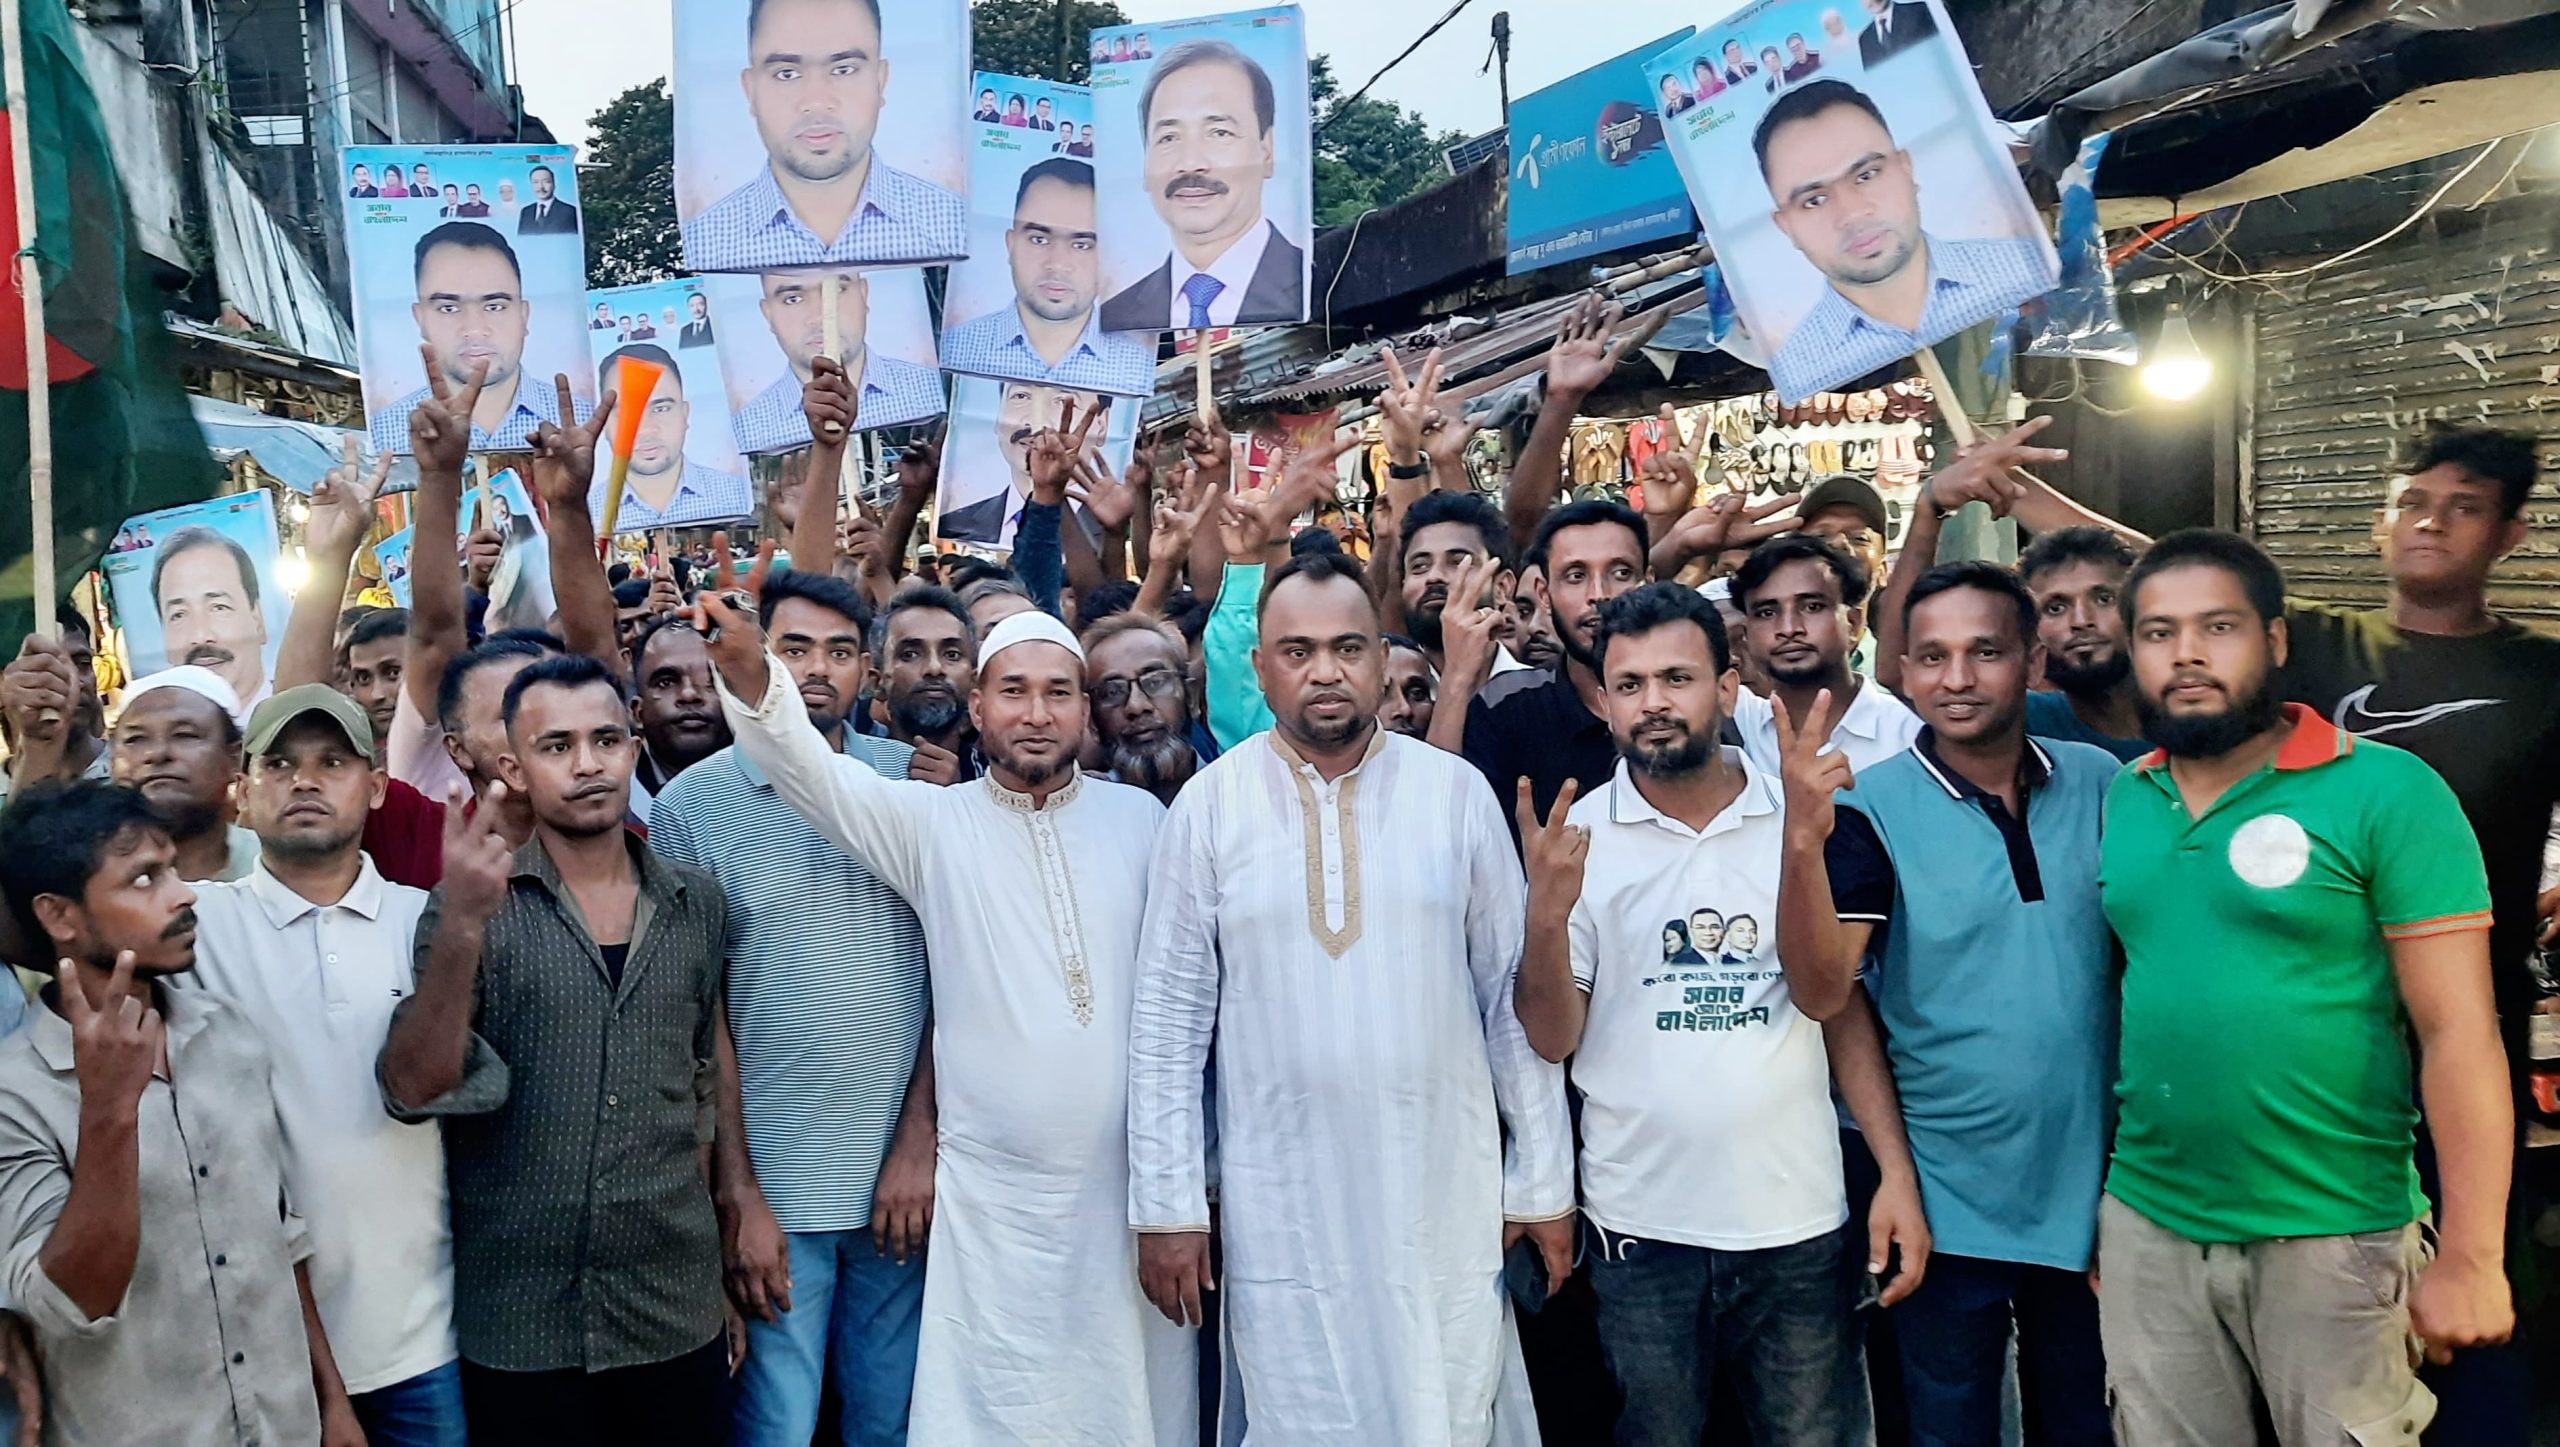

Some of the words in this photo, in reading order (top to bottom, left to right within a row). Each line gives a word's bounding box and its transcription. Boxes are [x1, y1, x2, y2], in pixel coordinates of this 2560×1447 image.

[1683, 986, 1745, 1008] সবার
[1655, 1006, 1769, 1032] বাংলাদেশ
[1694, 1004, 1731, 1015] আগে
